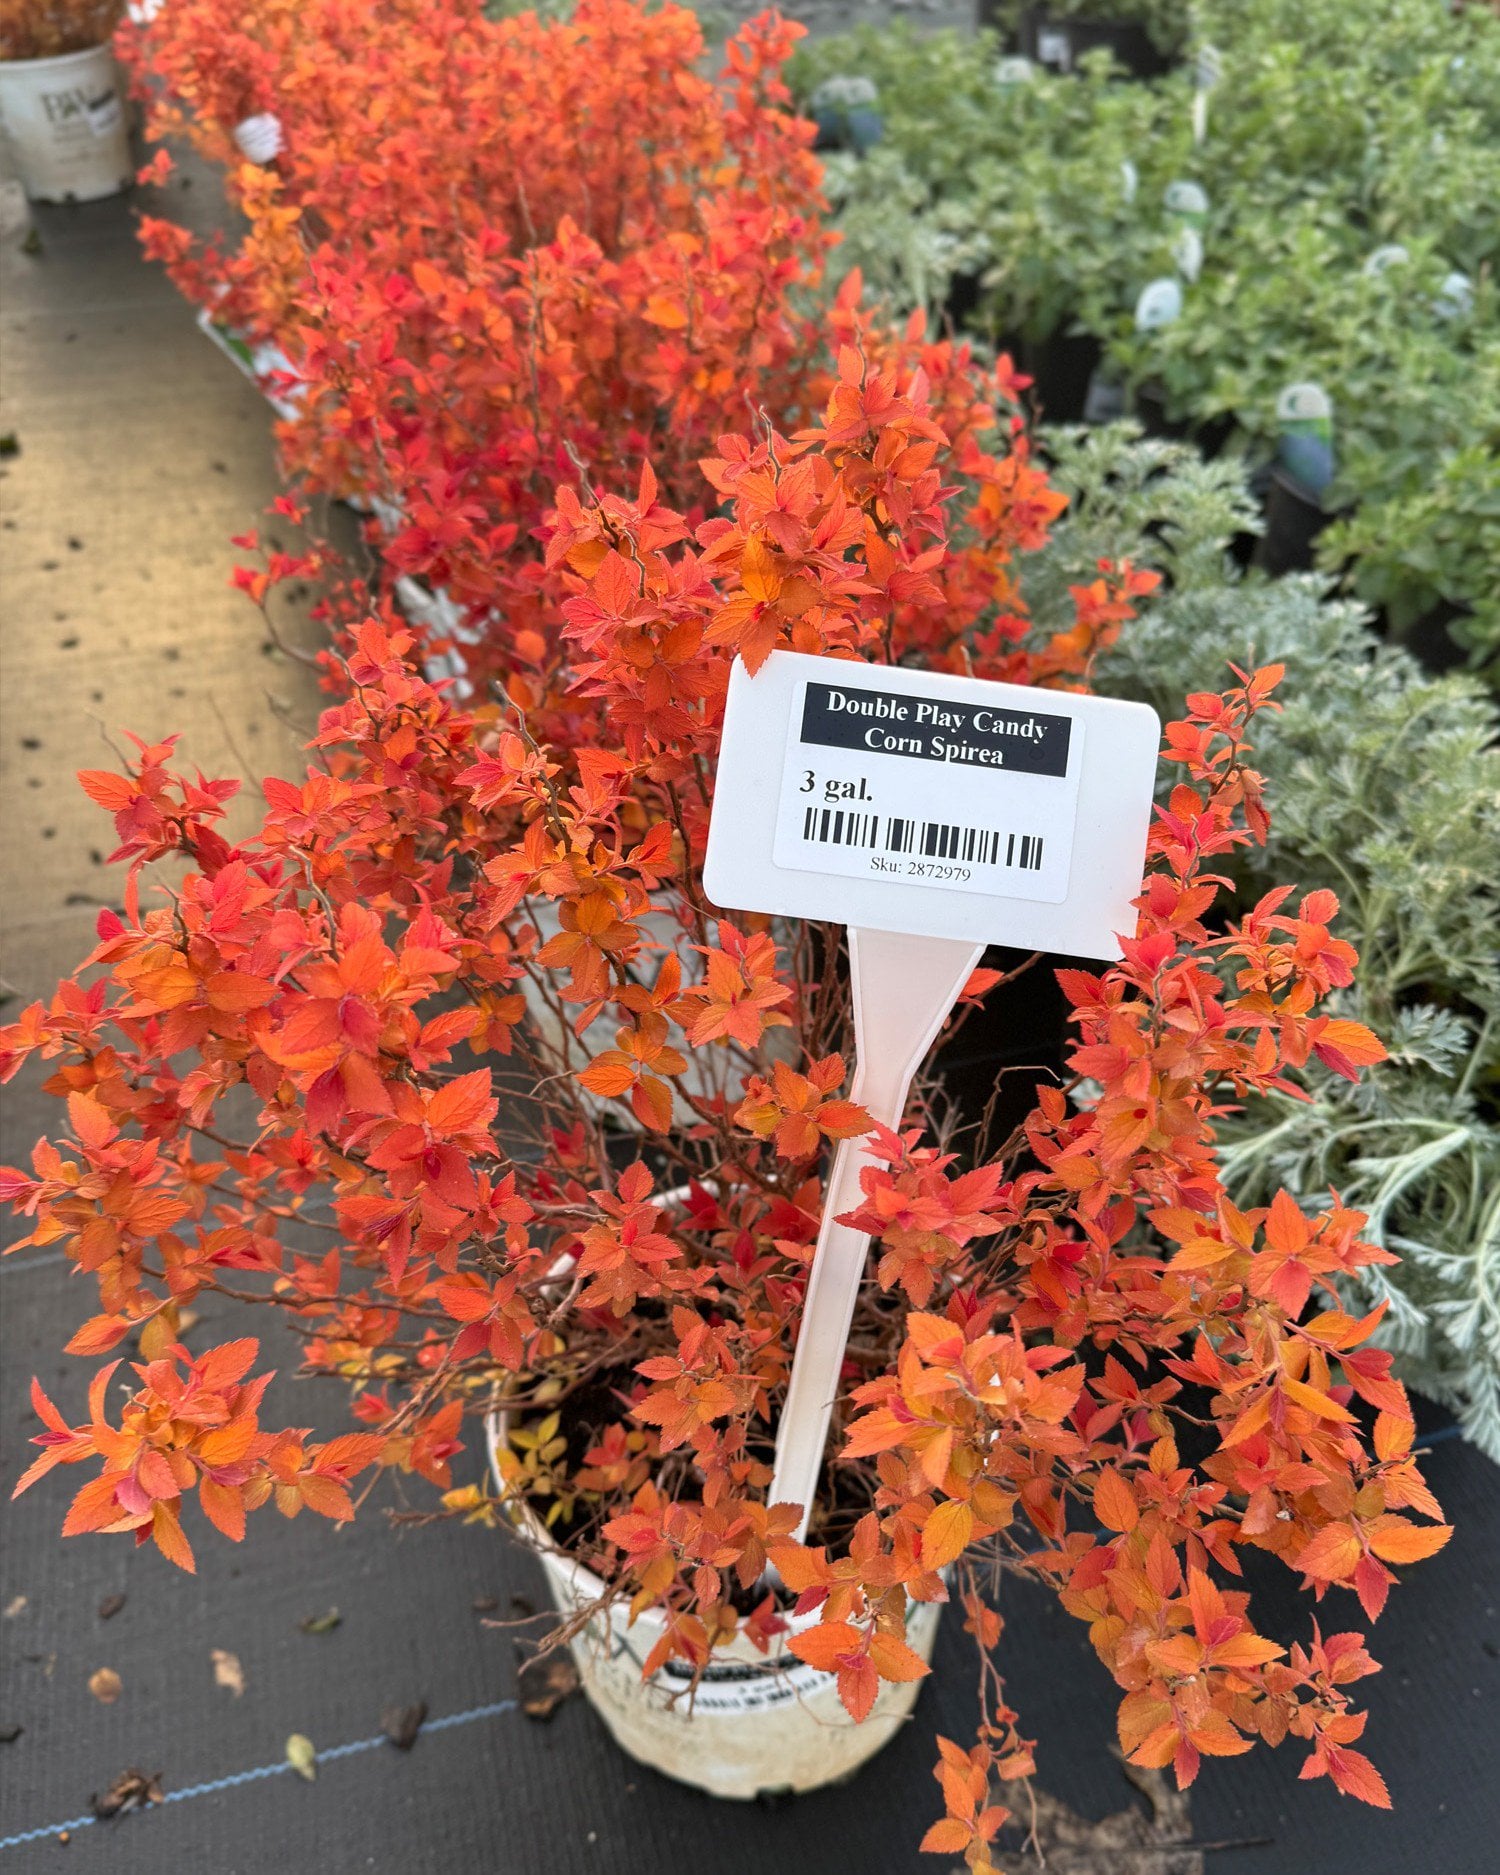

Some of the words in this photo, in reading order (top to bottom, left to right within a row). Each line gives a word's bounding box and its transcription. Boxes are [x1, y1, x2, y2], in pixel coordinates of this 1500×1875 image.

[827, 692, 908, 721] Double
[914, 703, 966, 733] Play
[972, 712, 1048, 744] Candy
[864, 728, 923, 754] Corn
[930, 736, 1004, 765] Spirea
[799, 770, 816, 793] 3
[824, 777, 874, 803] gal.
[870, 857, 902, 874] Sku:
[907, 861, 972, 882] 2872979
